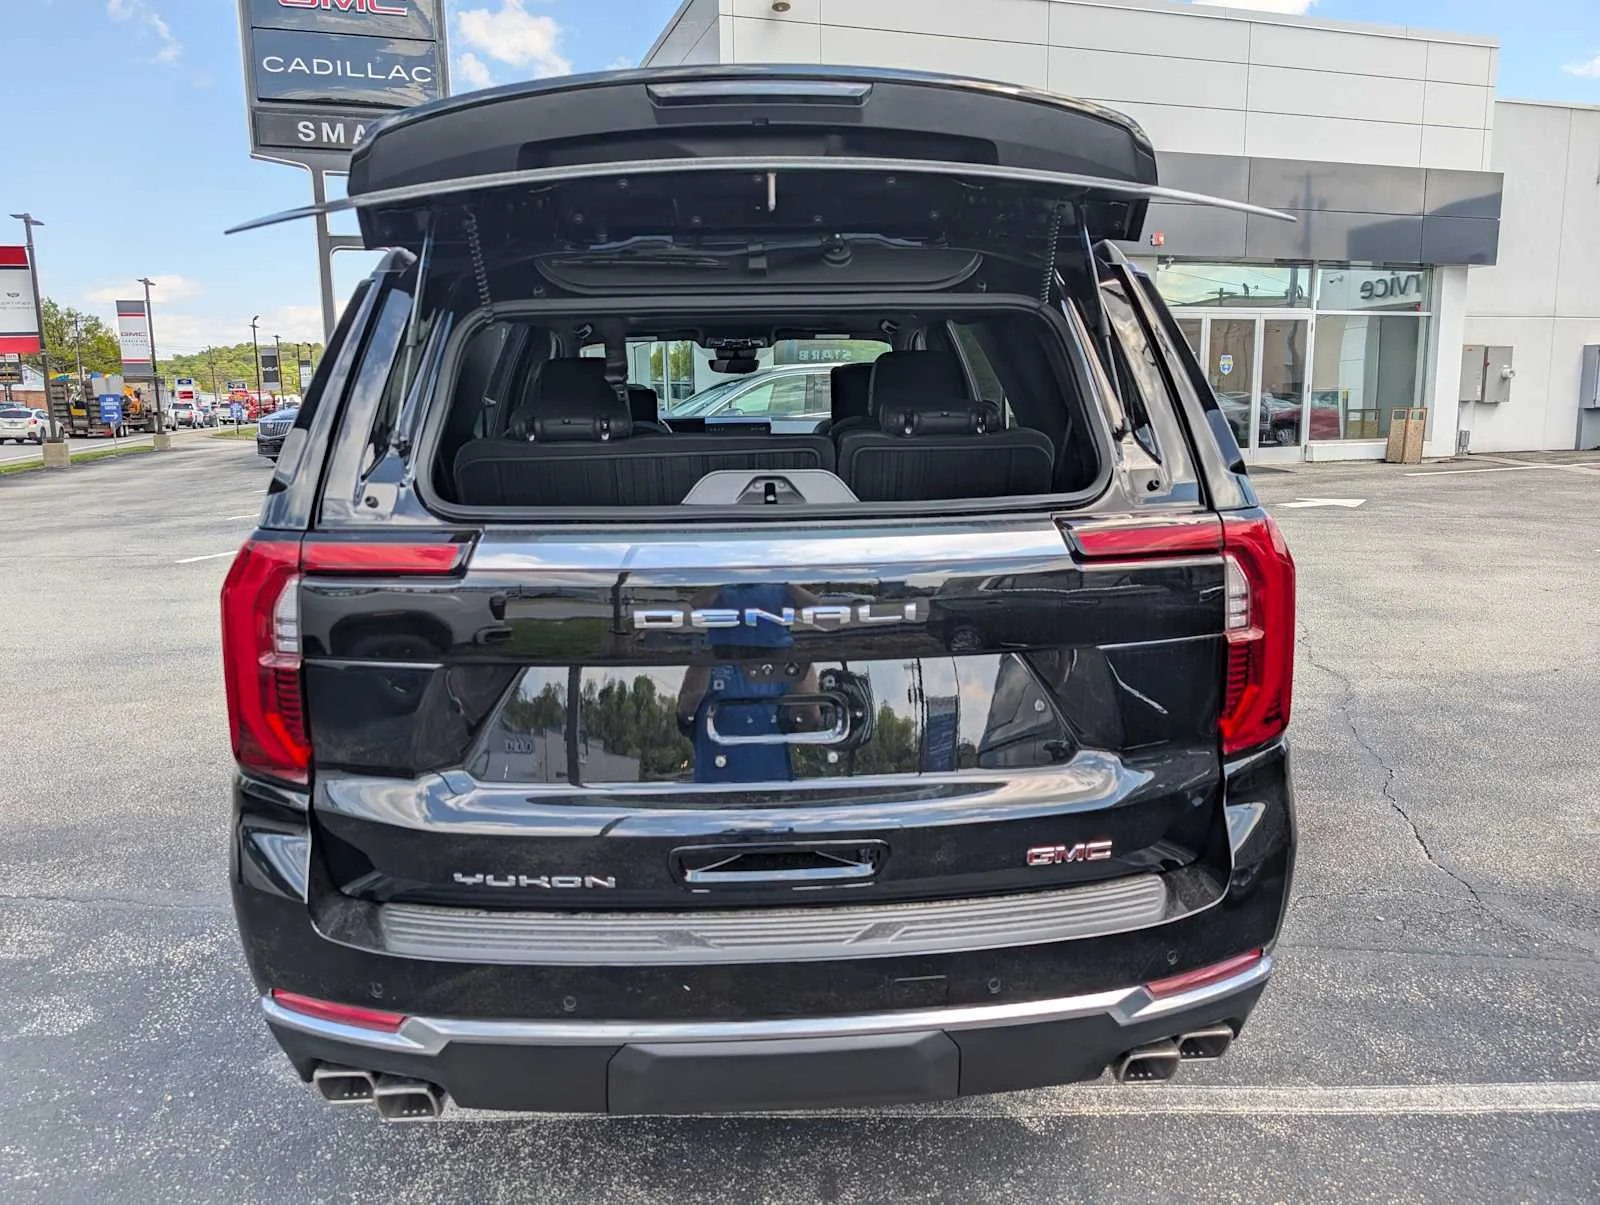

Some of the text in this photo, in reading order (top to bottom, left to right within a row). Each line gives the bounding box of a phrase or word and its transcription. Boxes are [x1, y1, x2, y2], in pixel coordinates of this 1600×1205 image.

[263, 56, 432, 82] CADILLAC
[633, 600, 917, 632] DENALI
[1027, 840, 1112, 866] GMC
[453, 872, 616, 889] YUKON
